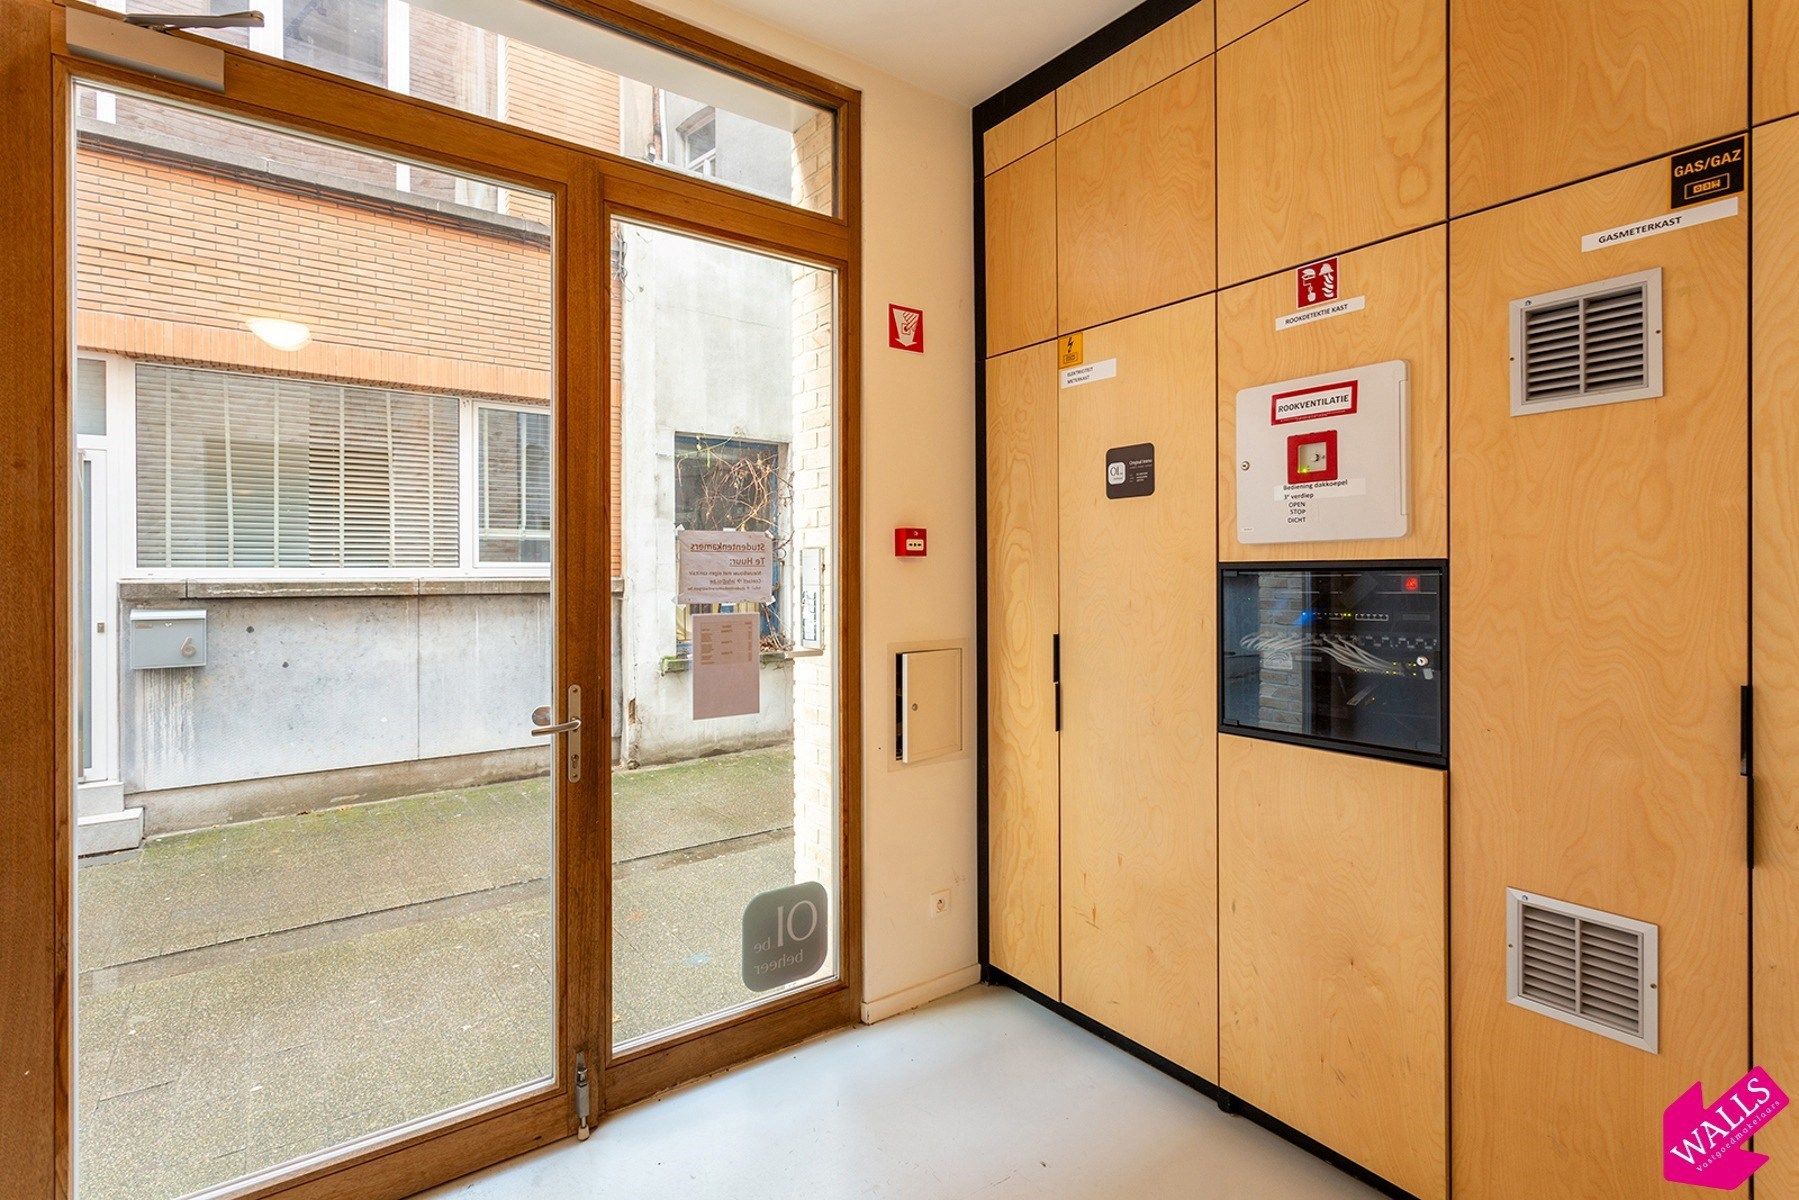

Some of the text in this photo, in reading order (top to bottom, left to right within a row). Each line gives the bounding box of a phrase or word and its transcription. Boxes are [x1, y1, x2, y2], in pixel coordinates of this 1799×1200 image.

[1673, 148, 1742, 178] GAS/GAZ
[1598, 216, 1682, 244] GASMETERKAST
[1284, 303, 1349, 325] ROOKDETEKTIE KAST
[1277, 394, 1350, 413] ROOKVENTILATIE
[1314, 479, 1348, 488] dakkoepel
[181, 636, 197, 658] 6
